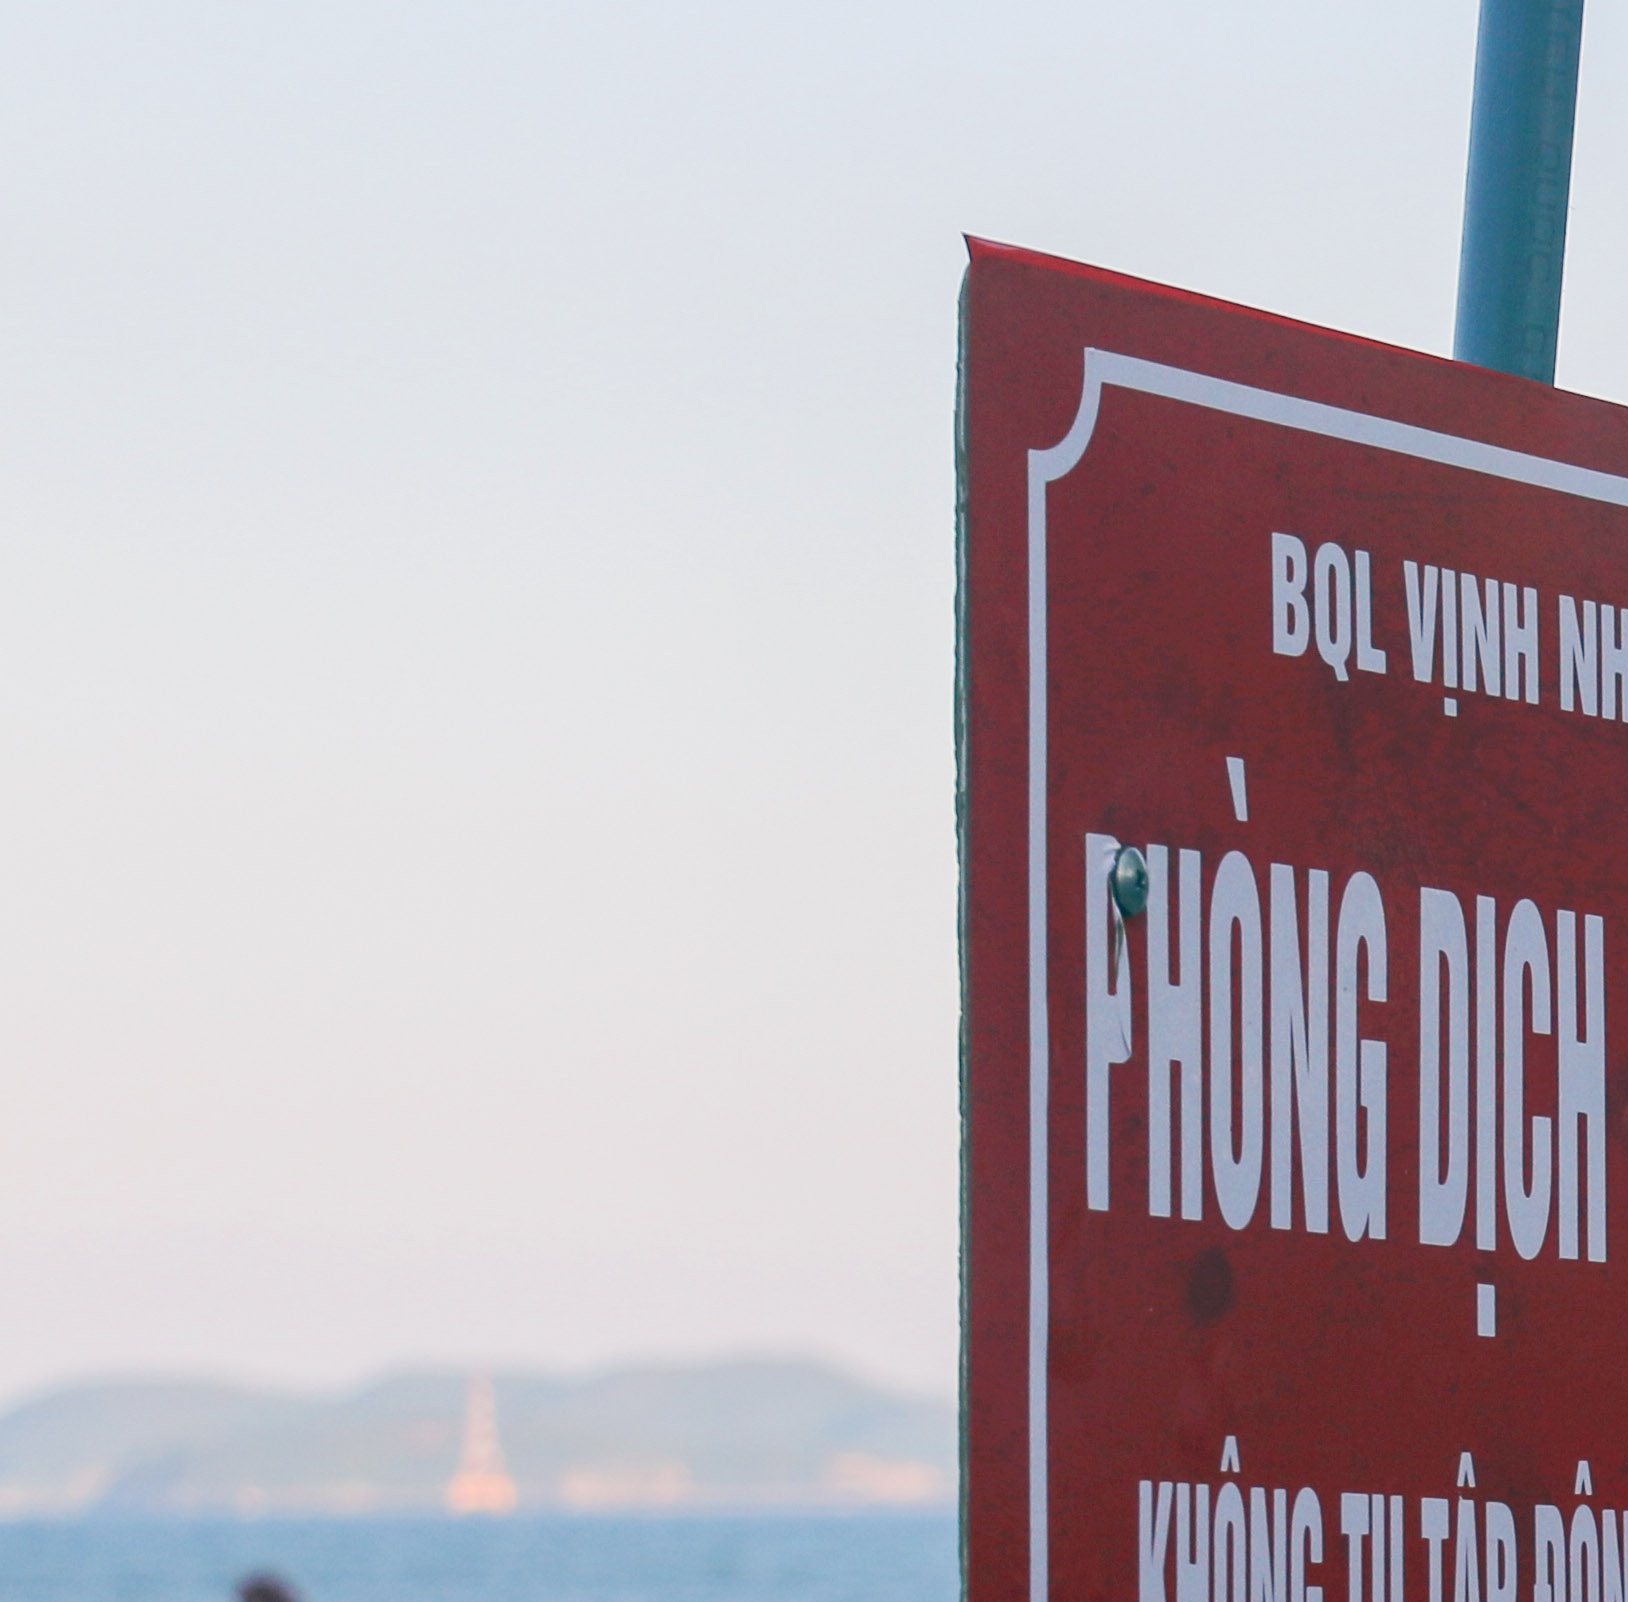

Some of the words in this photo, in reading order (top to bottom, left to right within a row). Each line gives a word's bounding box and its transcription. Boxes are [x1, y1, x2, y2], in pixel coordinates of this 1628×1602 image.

[1271, 532, 1387, 682] BQL
[1403, 560, 1540, 717] VỊNH
[1085, 756, 1388, 1243] PHÒNG
[1419, 886, 1607, 1338] DỊCH
